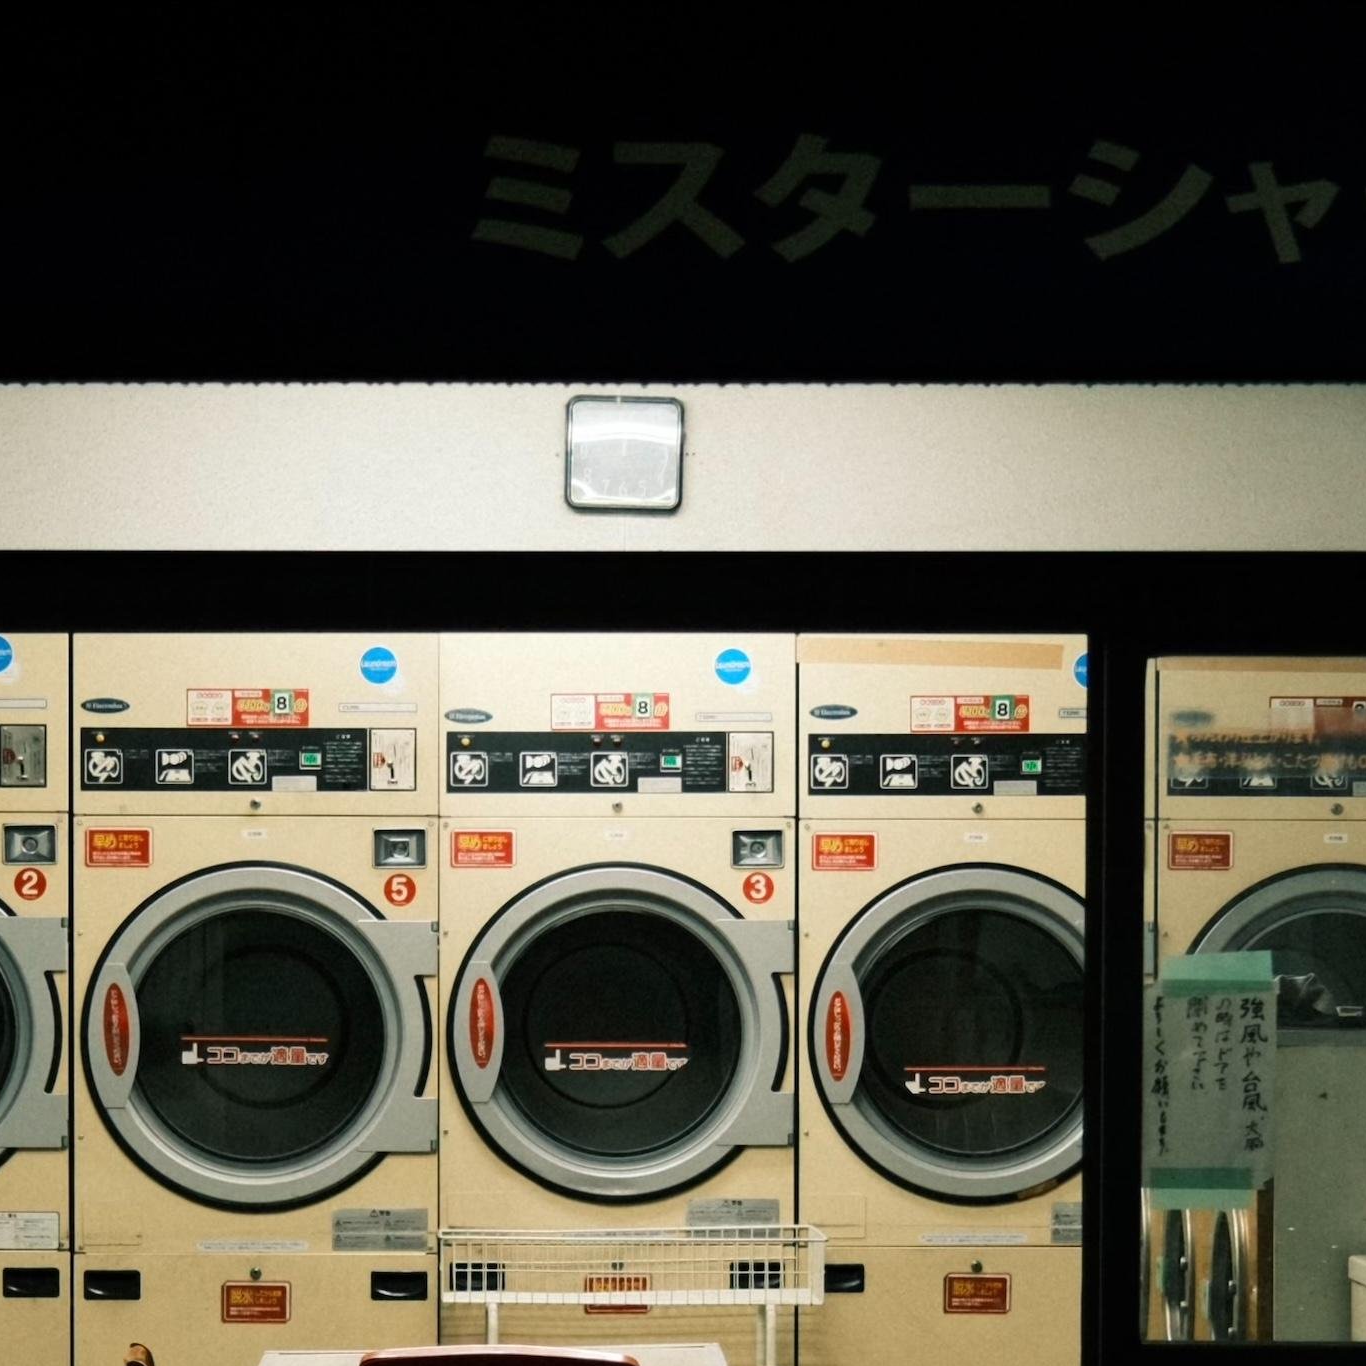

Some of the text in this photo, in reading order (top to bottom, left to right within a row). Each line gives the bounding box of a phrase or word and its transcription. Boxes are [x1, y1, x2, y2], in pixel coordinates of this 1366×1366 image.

[275, 695, 288, 711] 8
[637, 700, 648, 715] 8
[996, 703, 1008, 718] 8
[21, 872, 40, 896] 2
[390, 876, 409, 902] 5
[749, 876, 767, 900] 3
[206, 1046, 329, 1066] ココまでが適量です
